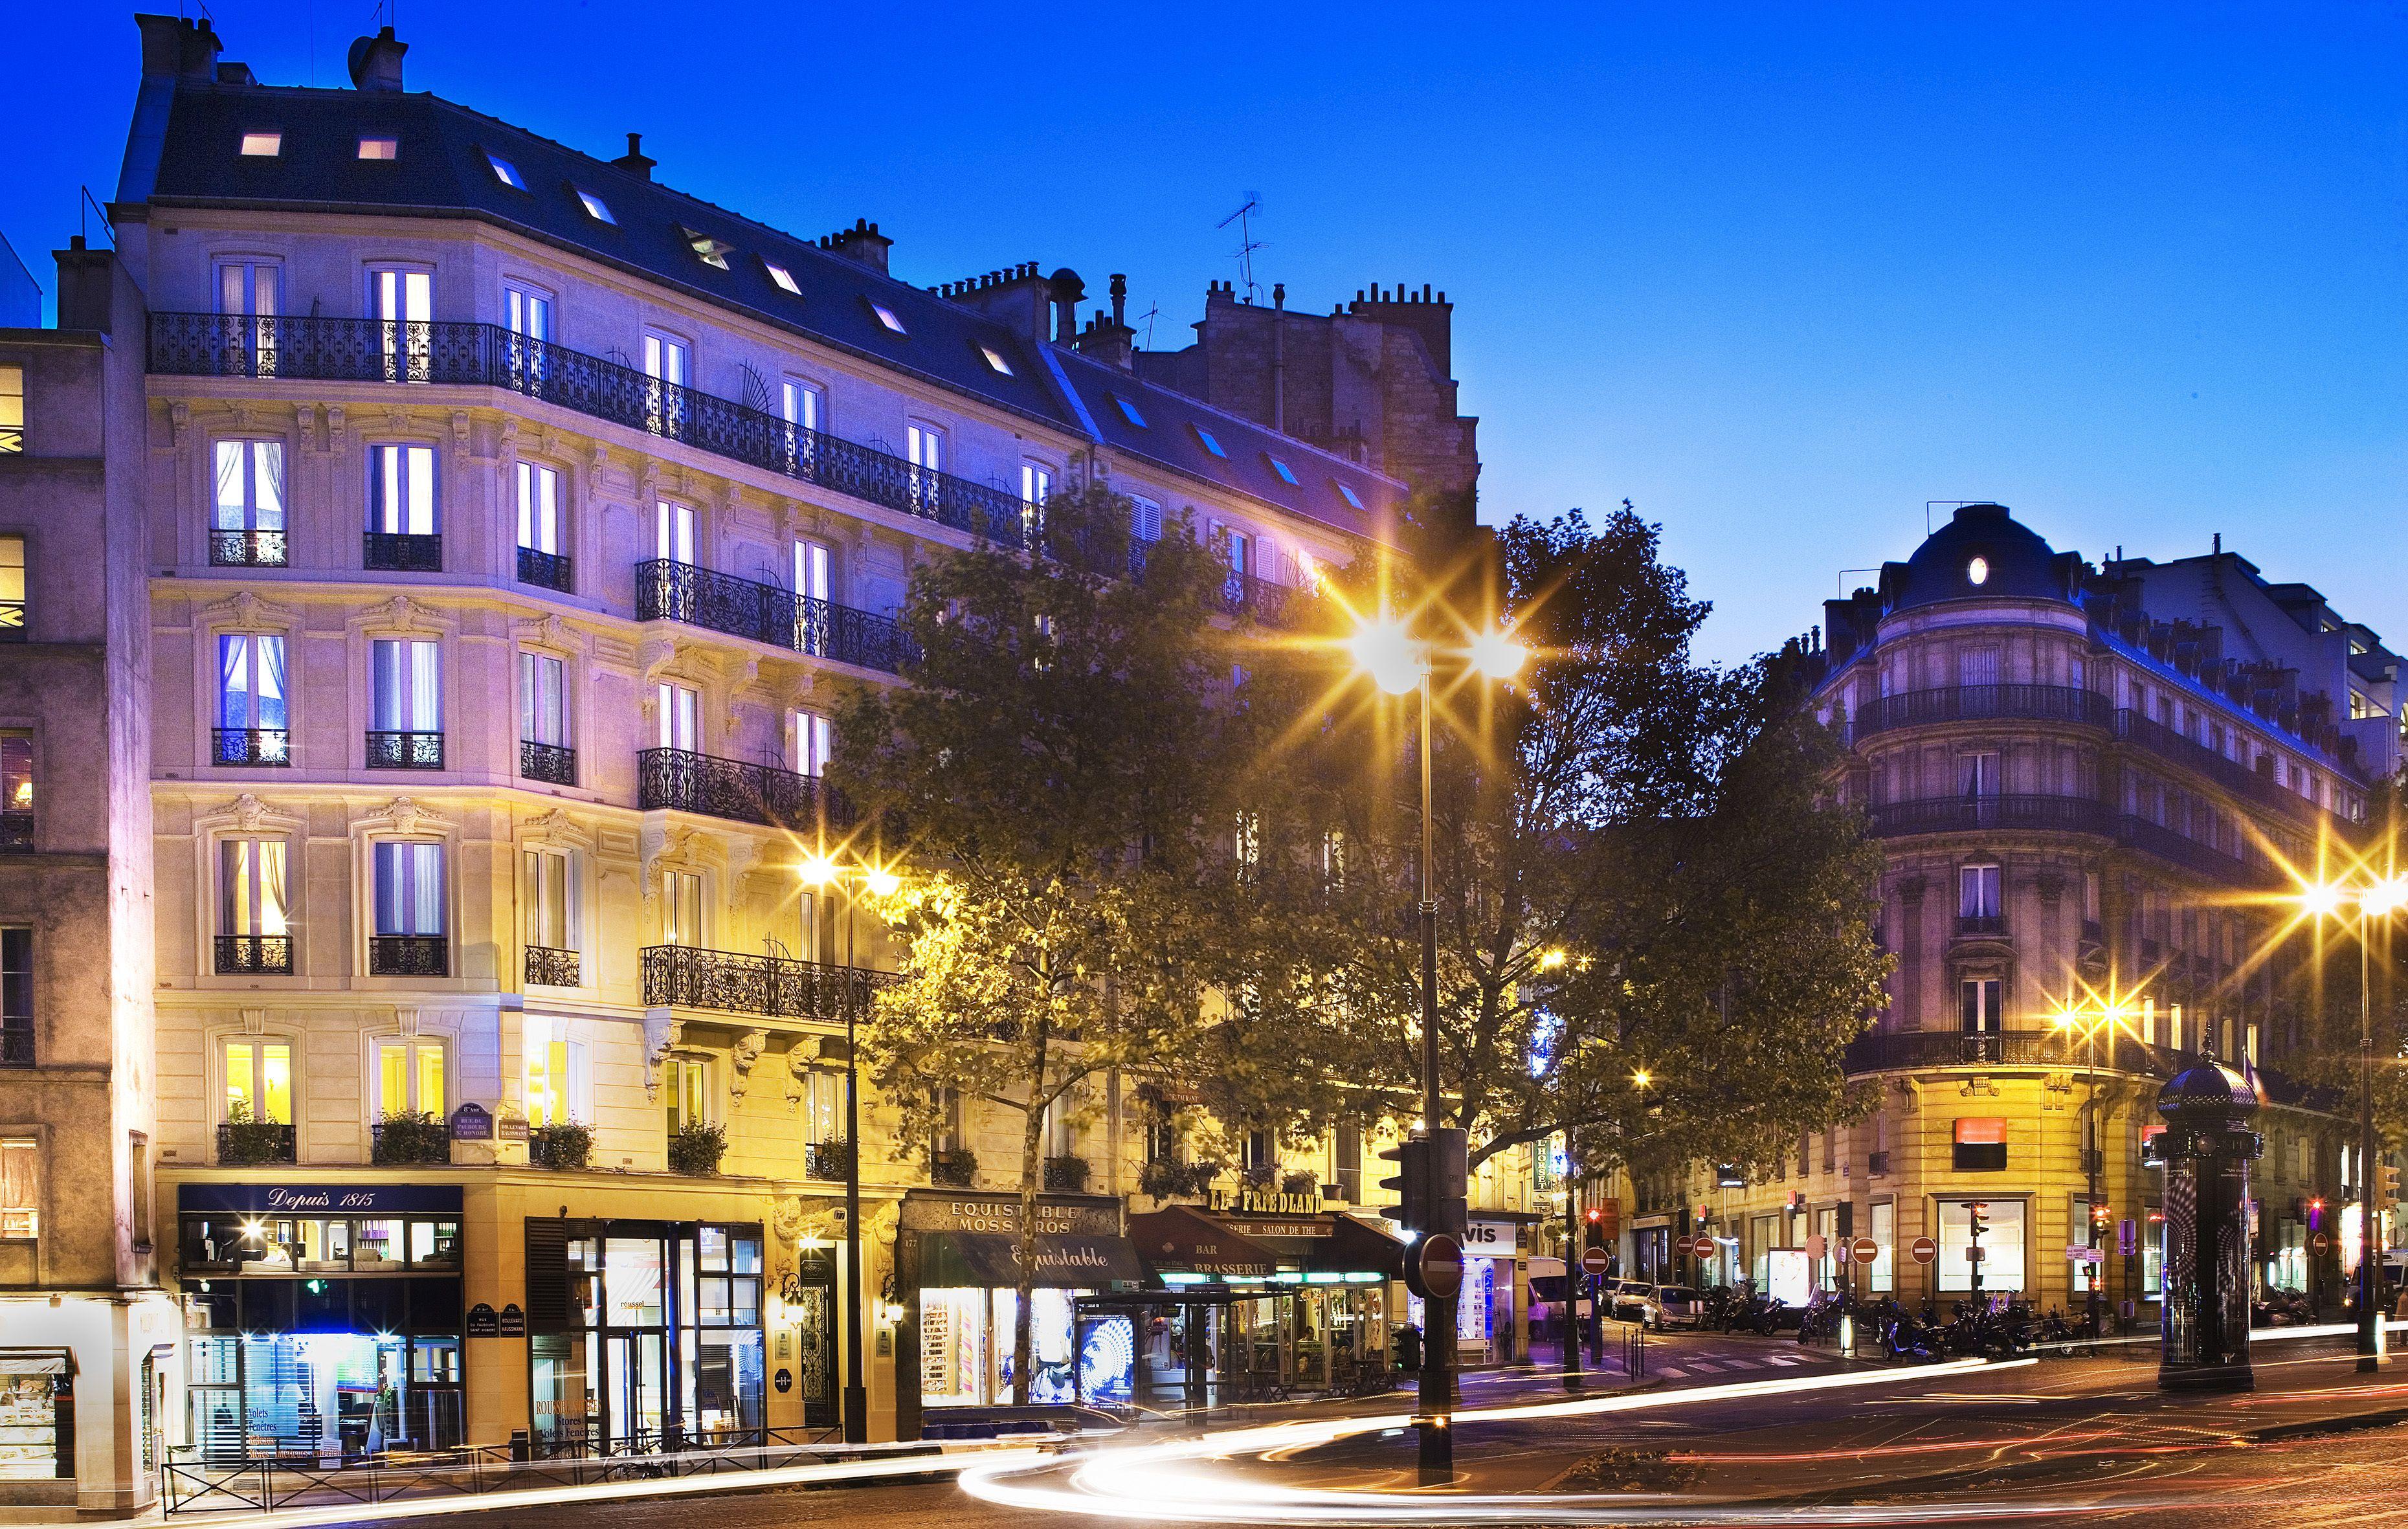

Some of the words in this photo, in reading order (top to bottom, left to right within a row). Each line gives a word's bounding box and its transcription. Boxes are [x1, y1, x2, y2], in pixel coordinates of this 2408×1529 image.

[269, 1188, 329, 1210] Depuis
[339, 1192, 376, 1206] 1815
[1210, 1190, 1229, 1211] LE
[1243, 1190, 1324, 1214] FRIEDLAND
[835, 1211, 845, 1220] 177
[952, 1203, 1077, 1219] EQUISTBLE
[959, 1218, 1014, 1233] MOSS
[1021, 1220, 1070, 1234] ROS
[1262, 1225, 1286, 1234] SALON
[1289, 1226, 1299, 1234] DE
[1302, 1226, 1316, 1235] THE
[1462, 1223, 1497, 1243] vis
[1196, 1245, 1218, 1255] BAR
[1195, 1264, 1269, 1276] BRASSERIE
[781, 1376, 787, 1386] H
[249, 1407, 269, 1419] Volets
[536, 1400, 570, 1415] ROUSSEL
[574, 1399, 602, 1413] STORES
[249, 1420, 277, 1432] Fenêtres
[557, 1416, 581, 1425] Stores
[565, 1427, 599, 1437] Fenêres
[249, 1435, 275, 1445] Rideaux
[249, 1449, 270, 1459] Stores
